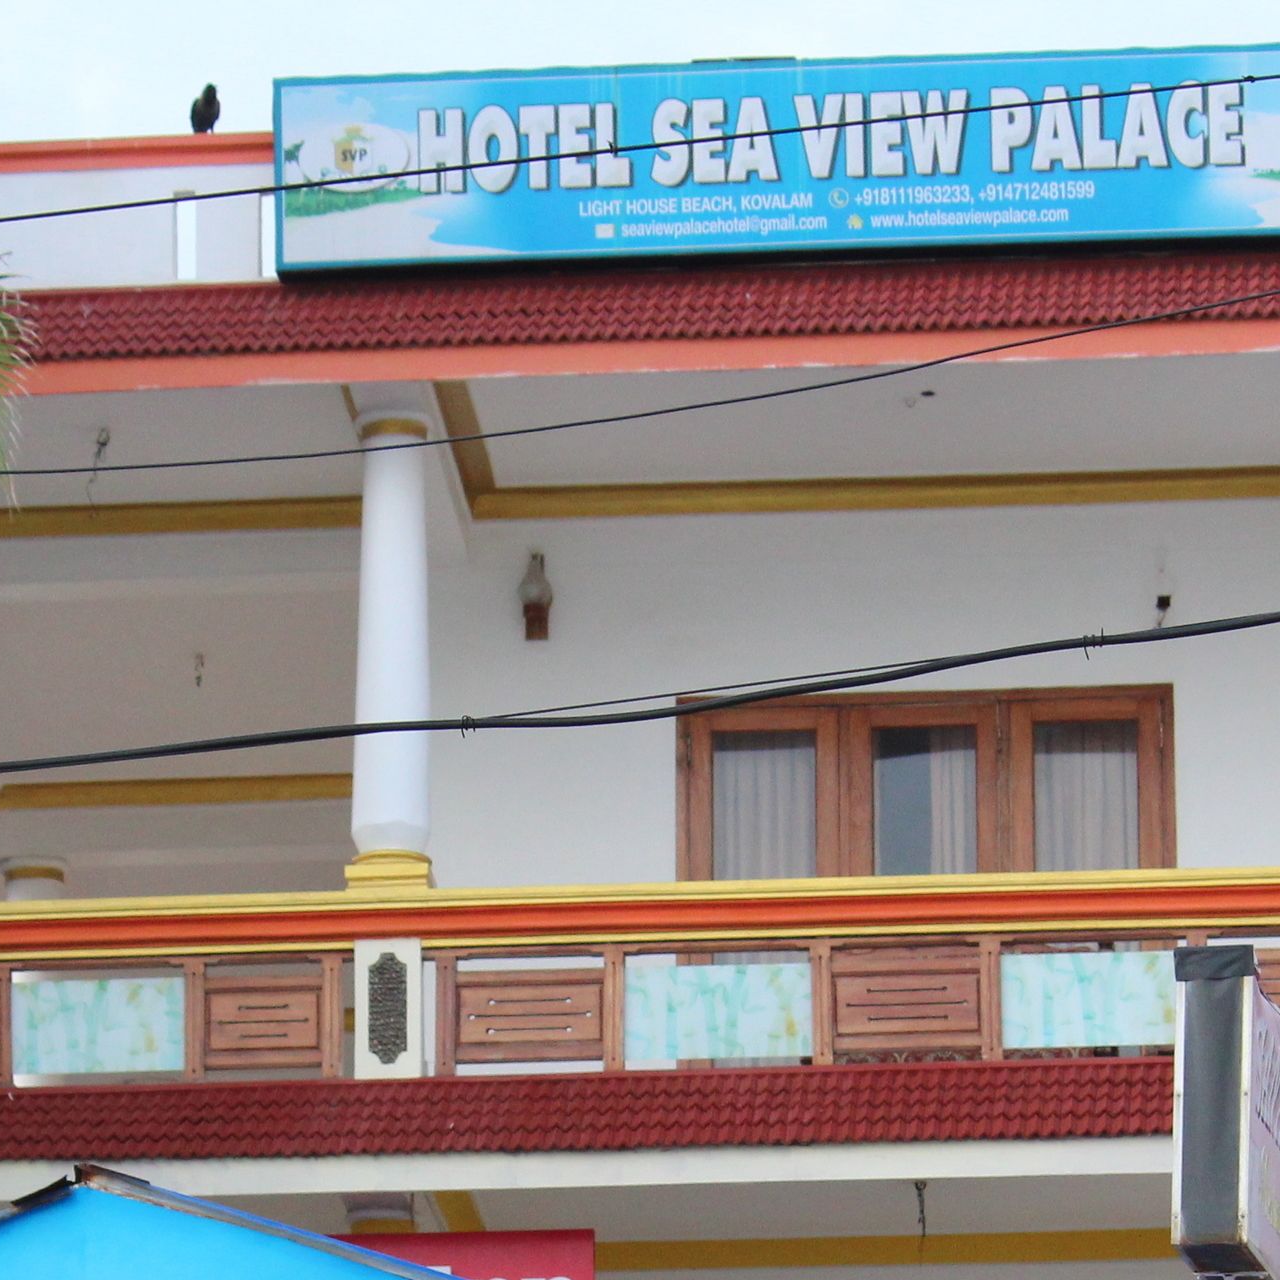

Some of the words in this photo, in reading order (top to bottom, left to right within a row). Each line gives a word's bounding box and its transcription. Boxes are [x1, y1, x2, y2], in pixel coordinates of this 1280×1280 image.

[418, 102, 634, 194] HOTEL
[651, 96, 780, 187] SEA
[793, 88, 971, 179] VIEW
[989, 79, 1248, 173] PALACE
[341, 149, 367, 162] SVP
[579, 199, 622, 217] LIGHT
[626, 197, 678, 215] HOUSE
[681, 194, 737, 214] BEACH,
[741, 192, 813, 211] KOVALAM
[622, 214, 828, 239] seaviewpalacehotel@gmail.com
[871, 207, 1069, 228] www.hotelseaviewpalace.com
